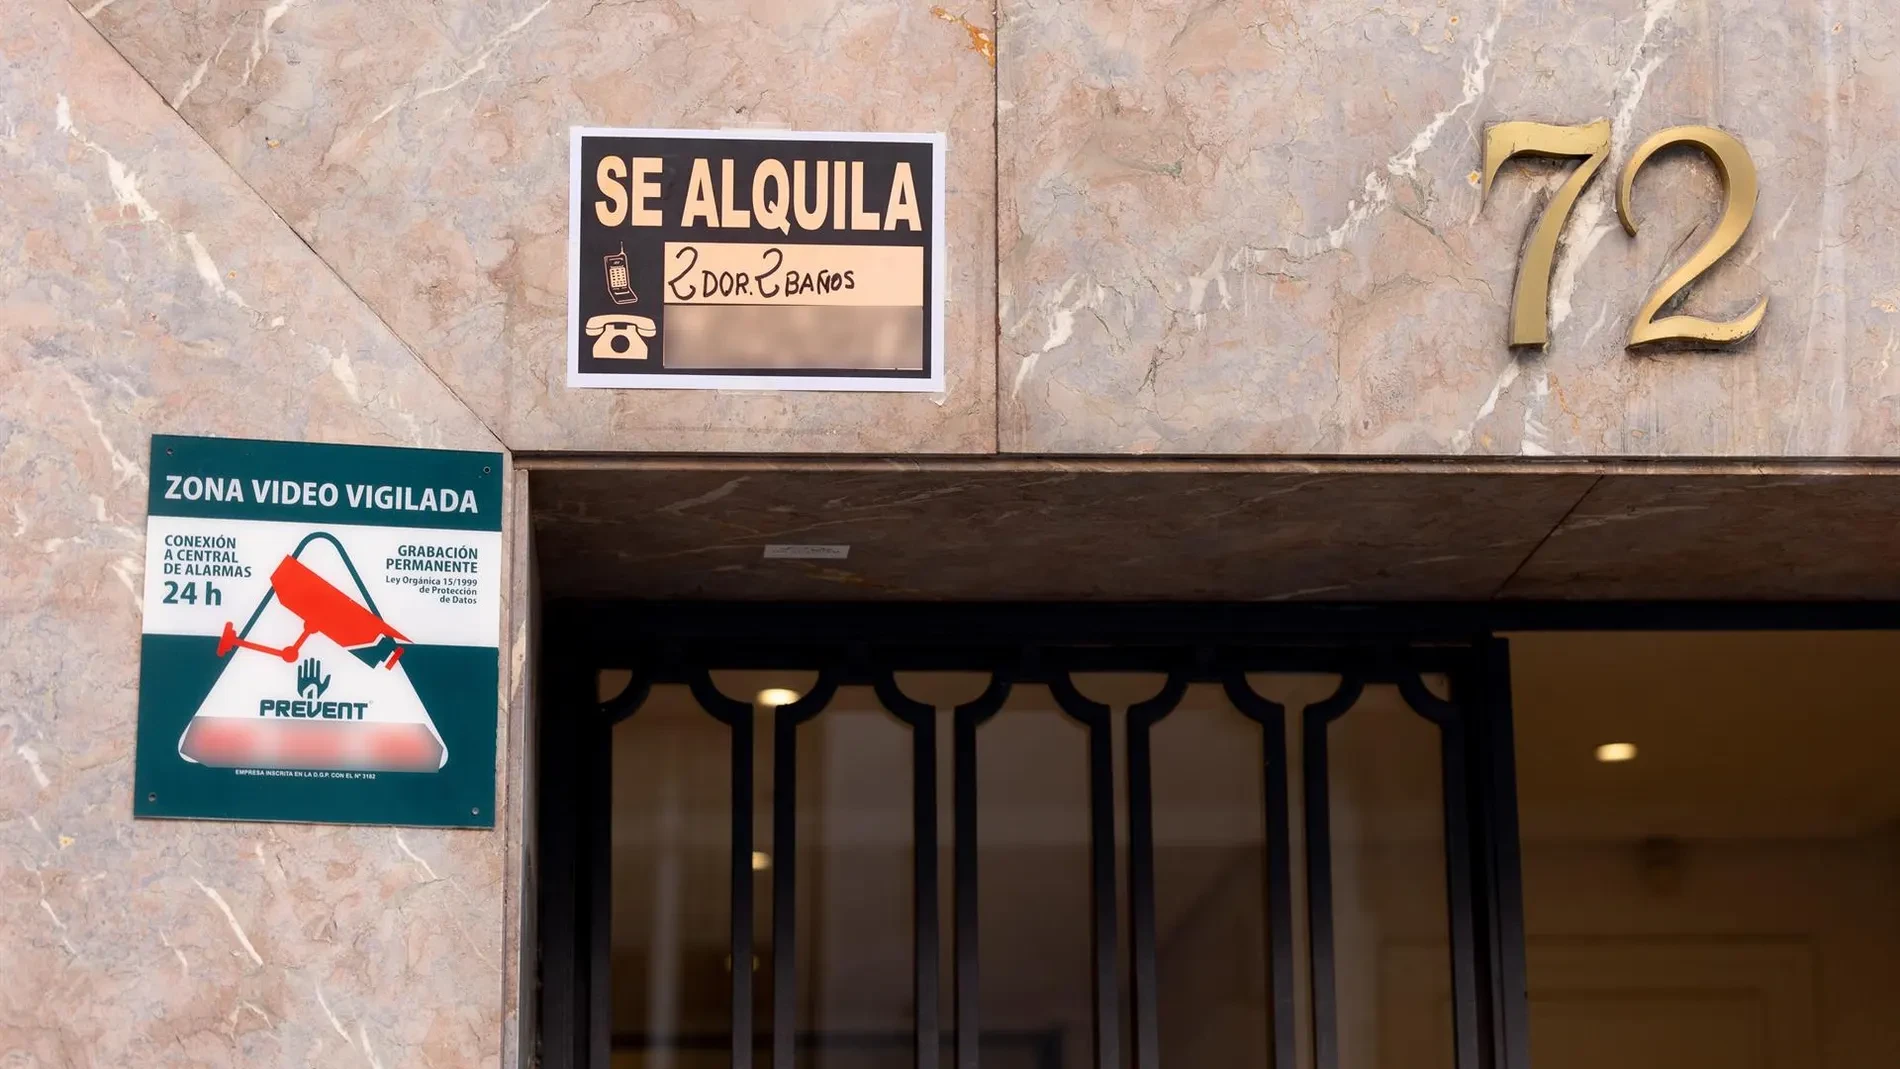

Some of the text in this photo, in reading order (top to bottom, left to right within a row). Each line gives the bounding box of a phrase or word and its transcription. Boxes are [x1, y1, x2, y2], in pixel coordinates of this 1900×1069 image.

[594, 155, 923, 236] SE ALQUILA
[1481, 117, 1769, 352] 72
[702, 270, 753, 298] DOR.
[785, 269, 855, 297] BAÑOS
[164, 475, 479, 514] ZONA VIDEO VIGILADA
[164, 534, 236, 549] CONEXIÓN
[163, 549, 239, 564] A CENTRAL
[397, 545, 478, 560] GRABACIÓN
[163, 563, 252, 578] DE ALARMAS
[386, 558, 478, 573] PERMANENTE
[385, 576, 478, 587] Ley Orgánica 15/1999
[162, 580, 222, 606] 24 h
[419, 586, 477, 596] de Protección
[439, 595, 477, 604] de Datos
[259, 699, 368, 720] PREVENT
